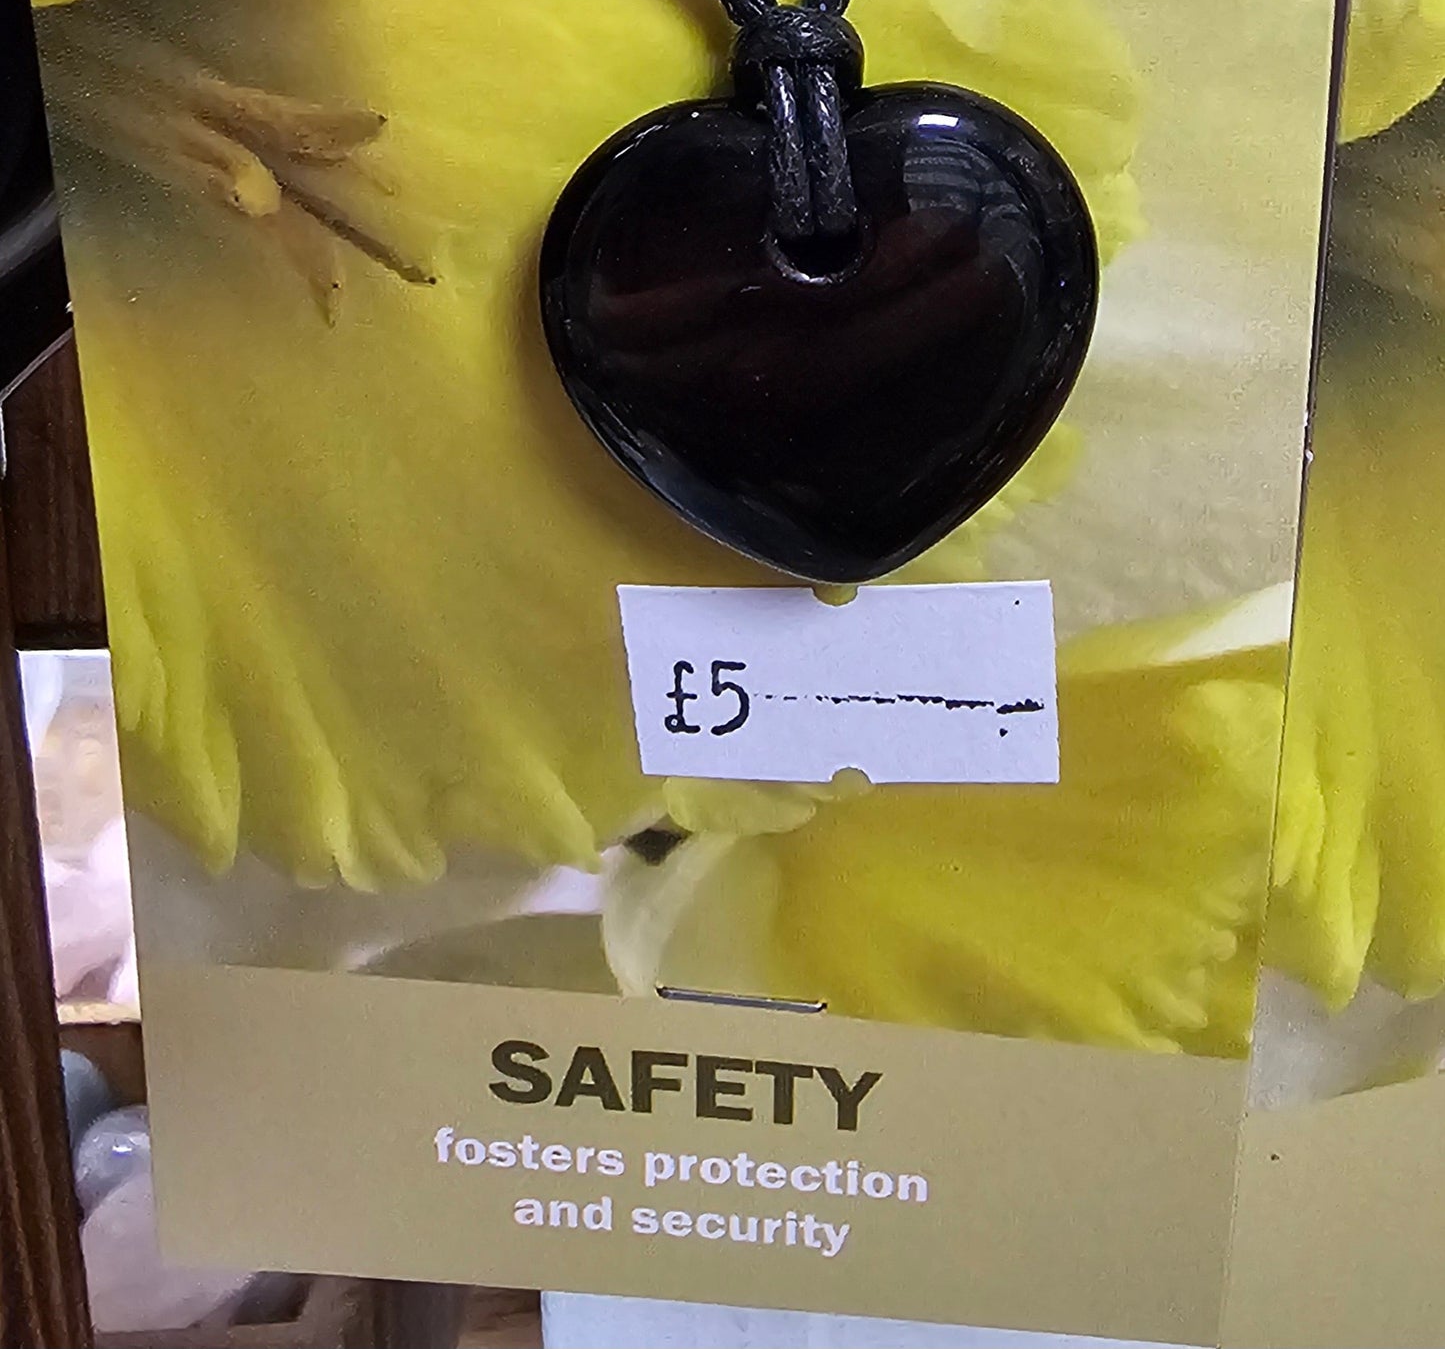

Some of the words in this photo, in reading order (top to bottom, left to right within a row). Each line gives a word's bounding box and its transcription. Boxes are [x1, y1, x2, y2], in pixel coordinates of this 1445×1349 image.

[488, 1039, 883, 1131] SAFETY
[434, 1126, 625, 1177] fosters
[644, 1149, 929, 1203] protection
[513, 1195, 613, 1232] and
[631, 1204, 851, 1258] security
